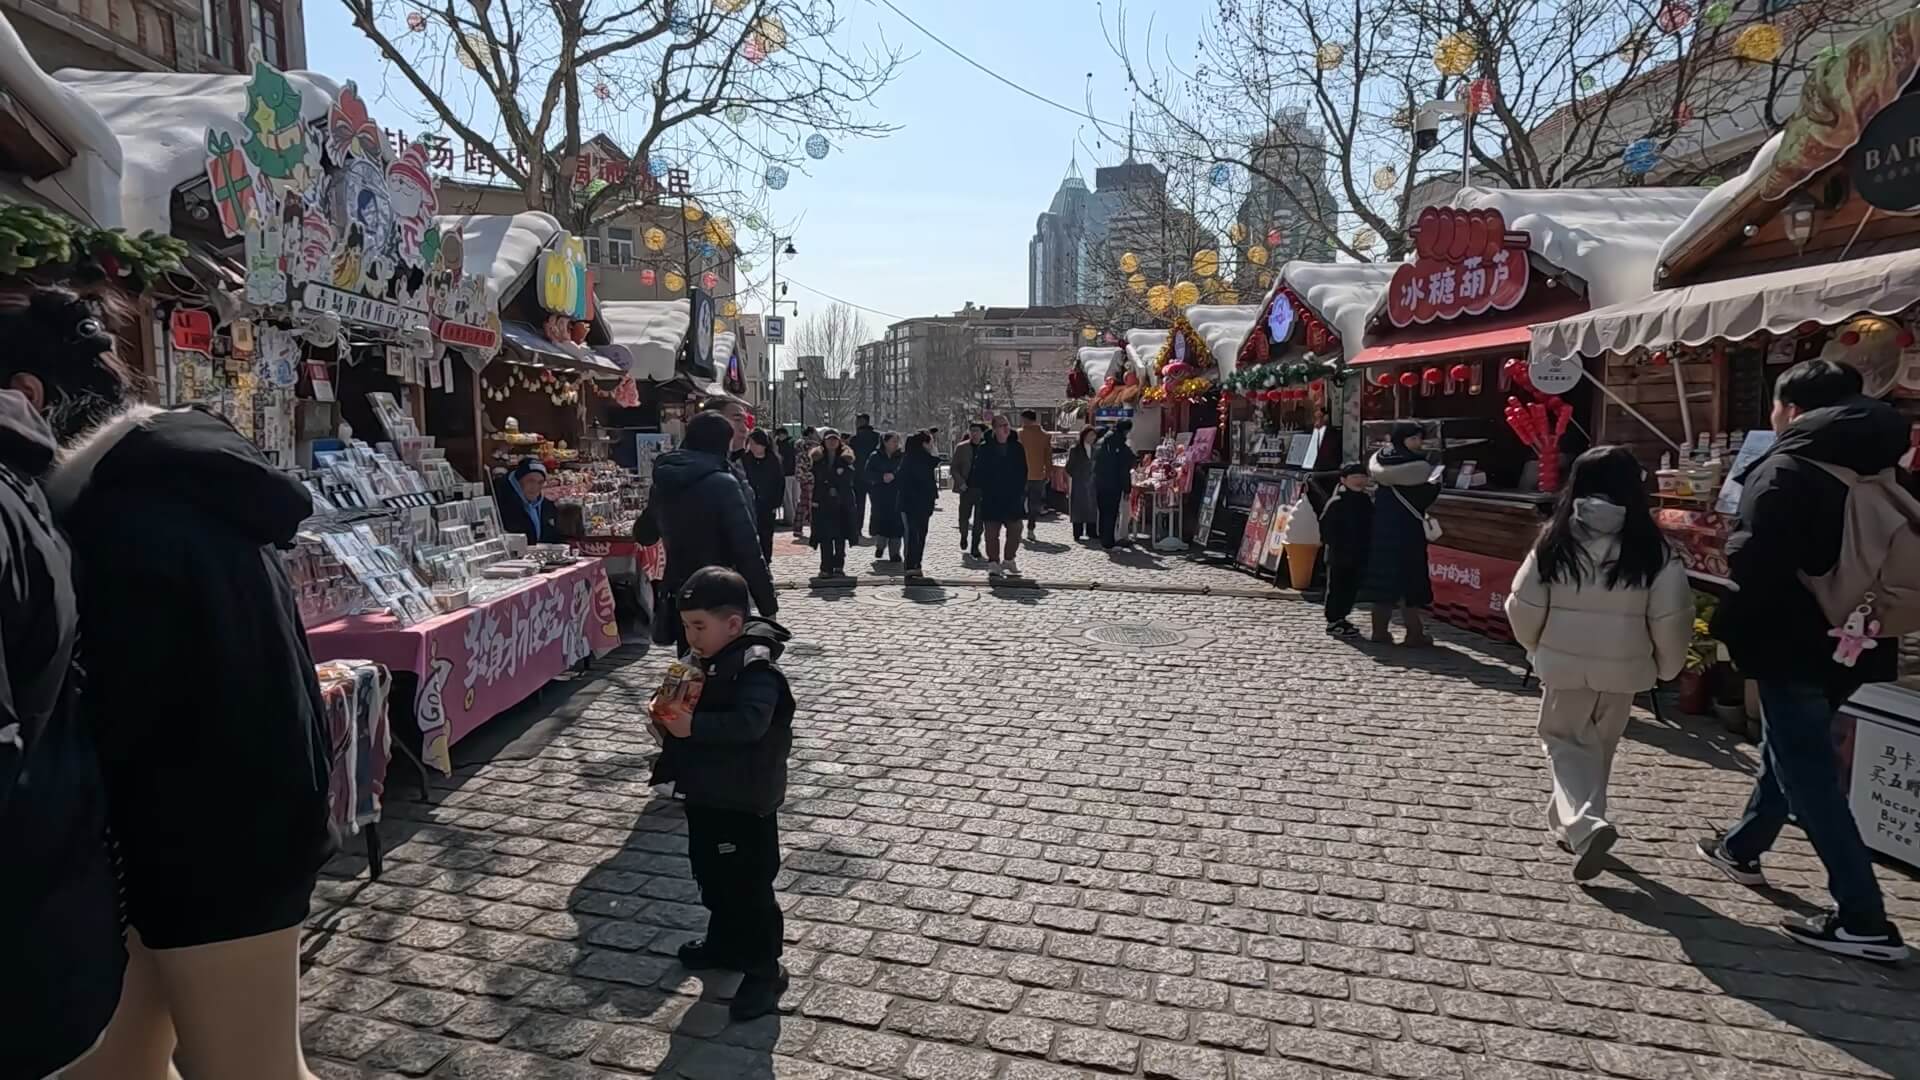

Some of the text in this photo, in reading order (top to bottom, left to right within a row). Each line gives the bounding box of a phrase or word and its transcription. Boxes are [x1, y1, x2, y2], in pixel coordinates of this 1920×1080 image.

[1401, 250, 1510, 311] 冰糖葫芦
[1880, 745, 1920, 774] 马卡
[1881, 809, 1907, 831] Buy
[1877, 822, 1913, 846] Free
